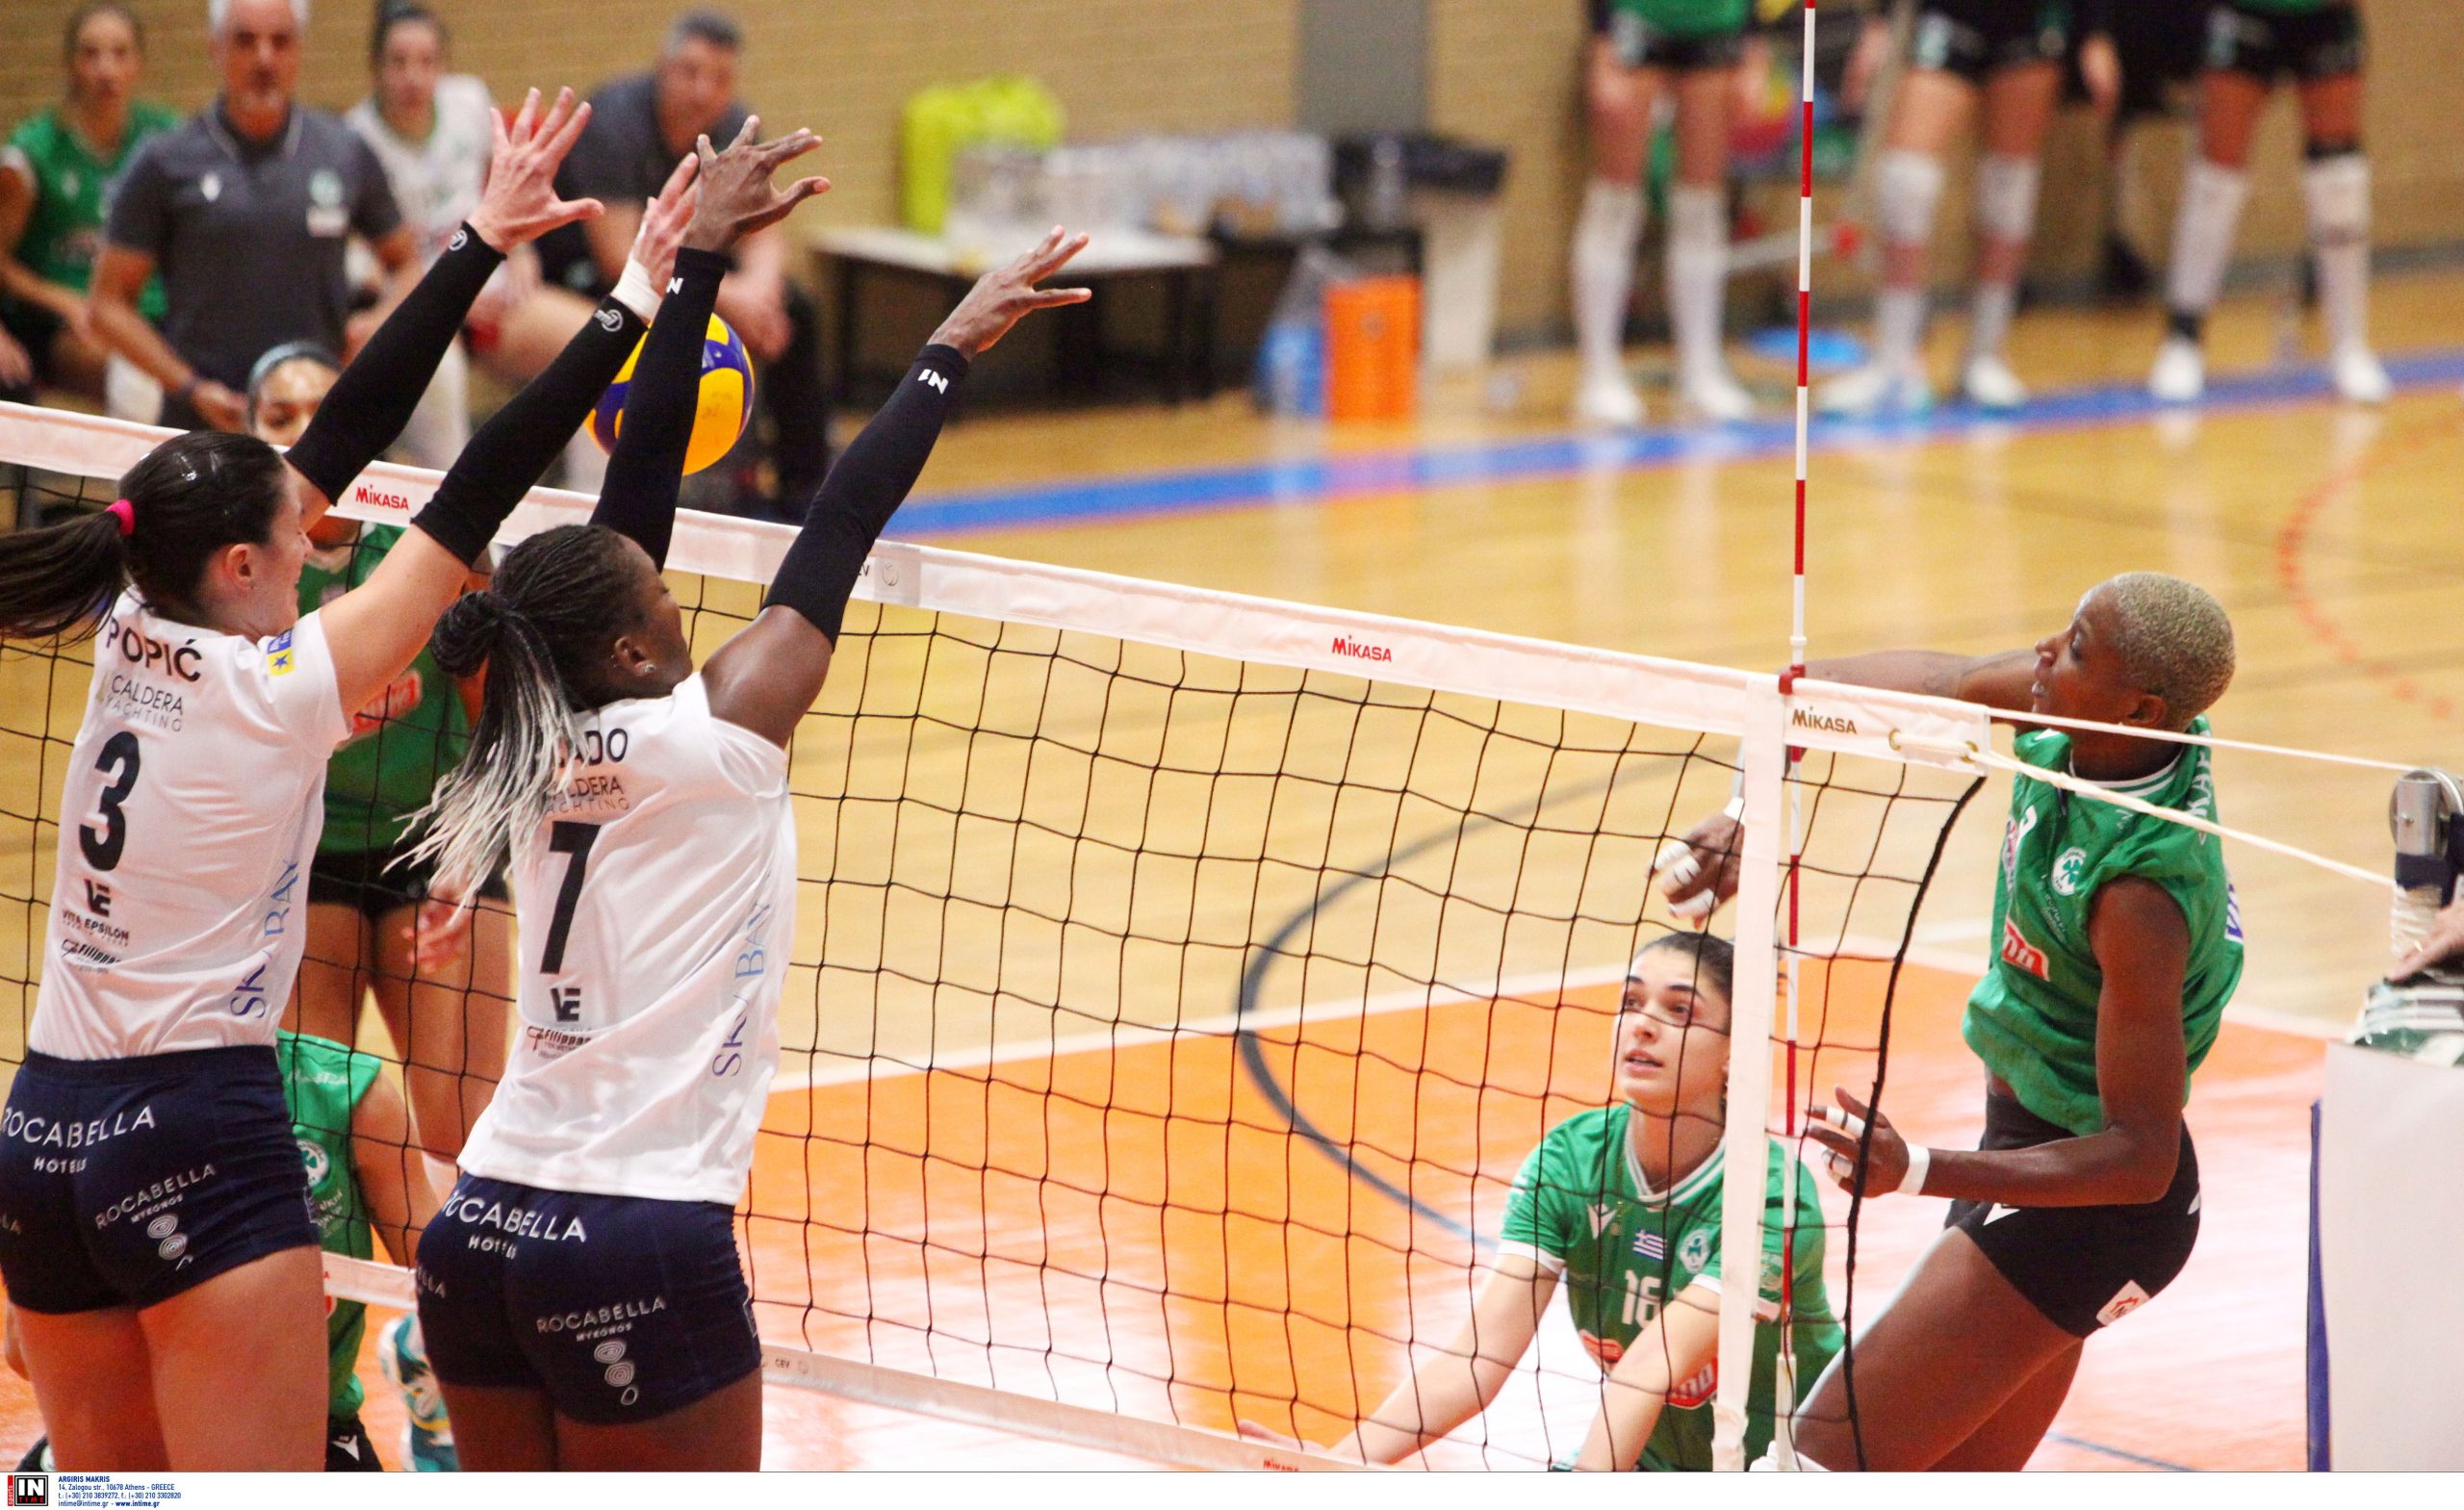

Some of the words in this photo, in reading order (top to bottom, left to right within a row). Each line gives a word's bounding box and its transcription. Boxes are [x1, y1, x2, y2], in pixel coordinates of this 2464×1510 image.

[106, 617, 202, 682] POPIĆ
[106, 694, 182, 732] YACHTING
[112, 675, 183, 715] CALDERA
[79, 730, 141, 872] 3
[546, 797, 630, 815] ACHTING
[540, 820, 603, 975] 7
[84, 918, 129, 940] EPSILON
[95, 1164, 216, 1230] ROCABELLA
[131, 1194, 183, 1223] MYKONOS
[536, 1295, 666, 1333] ROCABELLA
[1622, 1269, 1662, 1330] 16
[576, 1322, 632, 1342] MYKONOS
